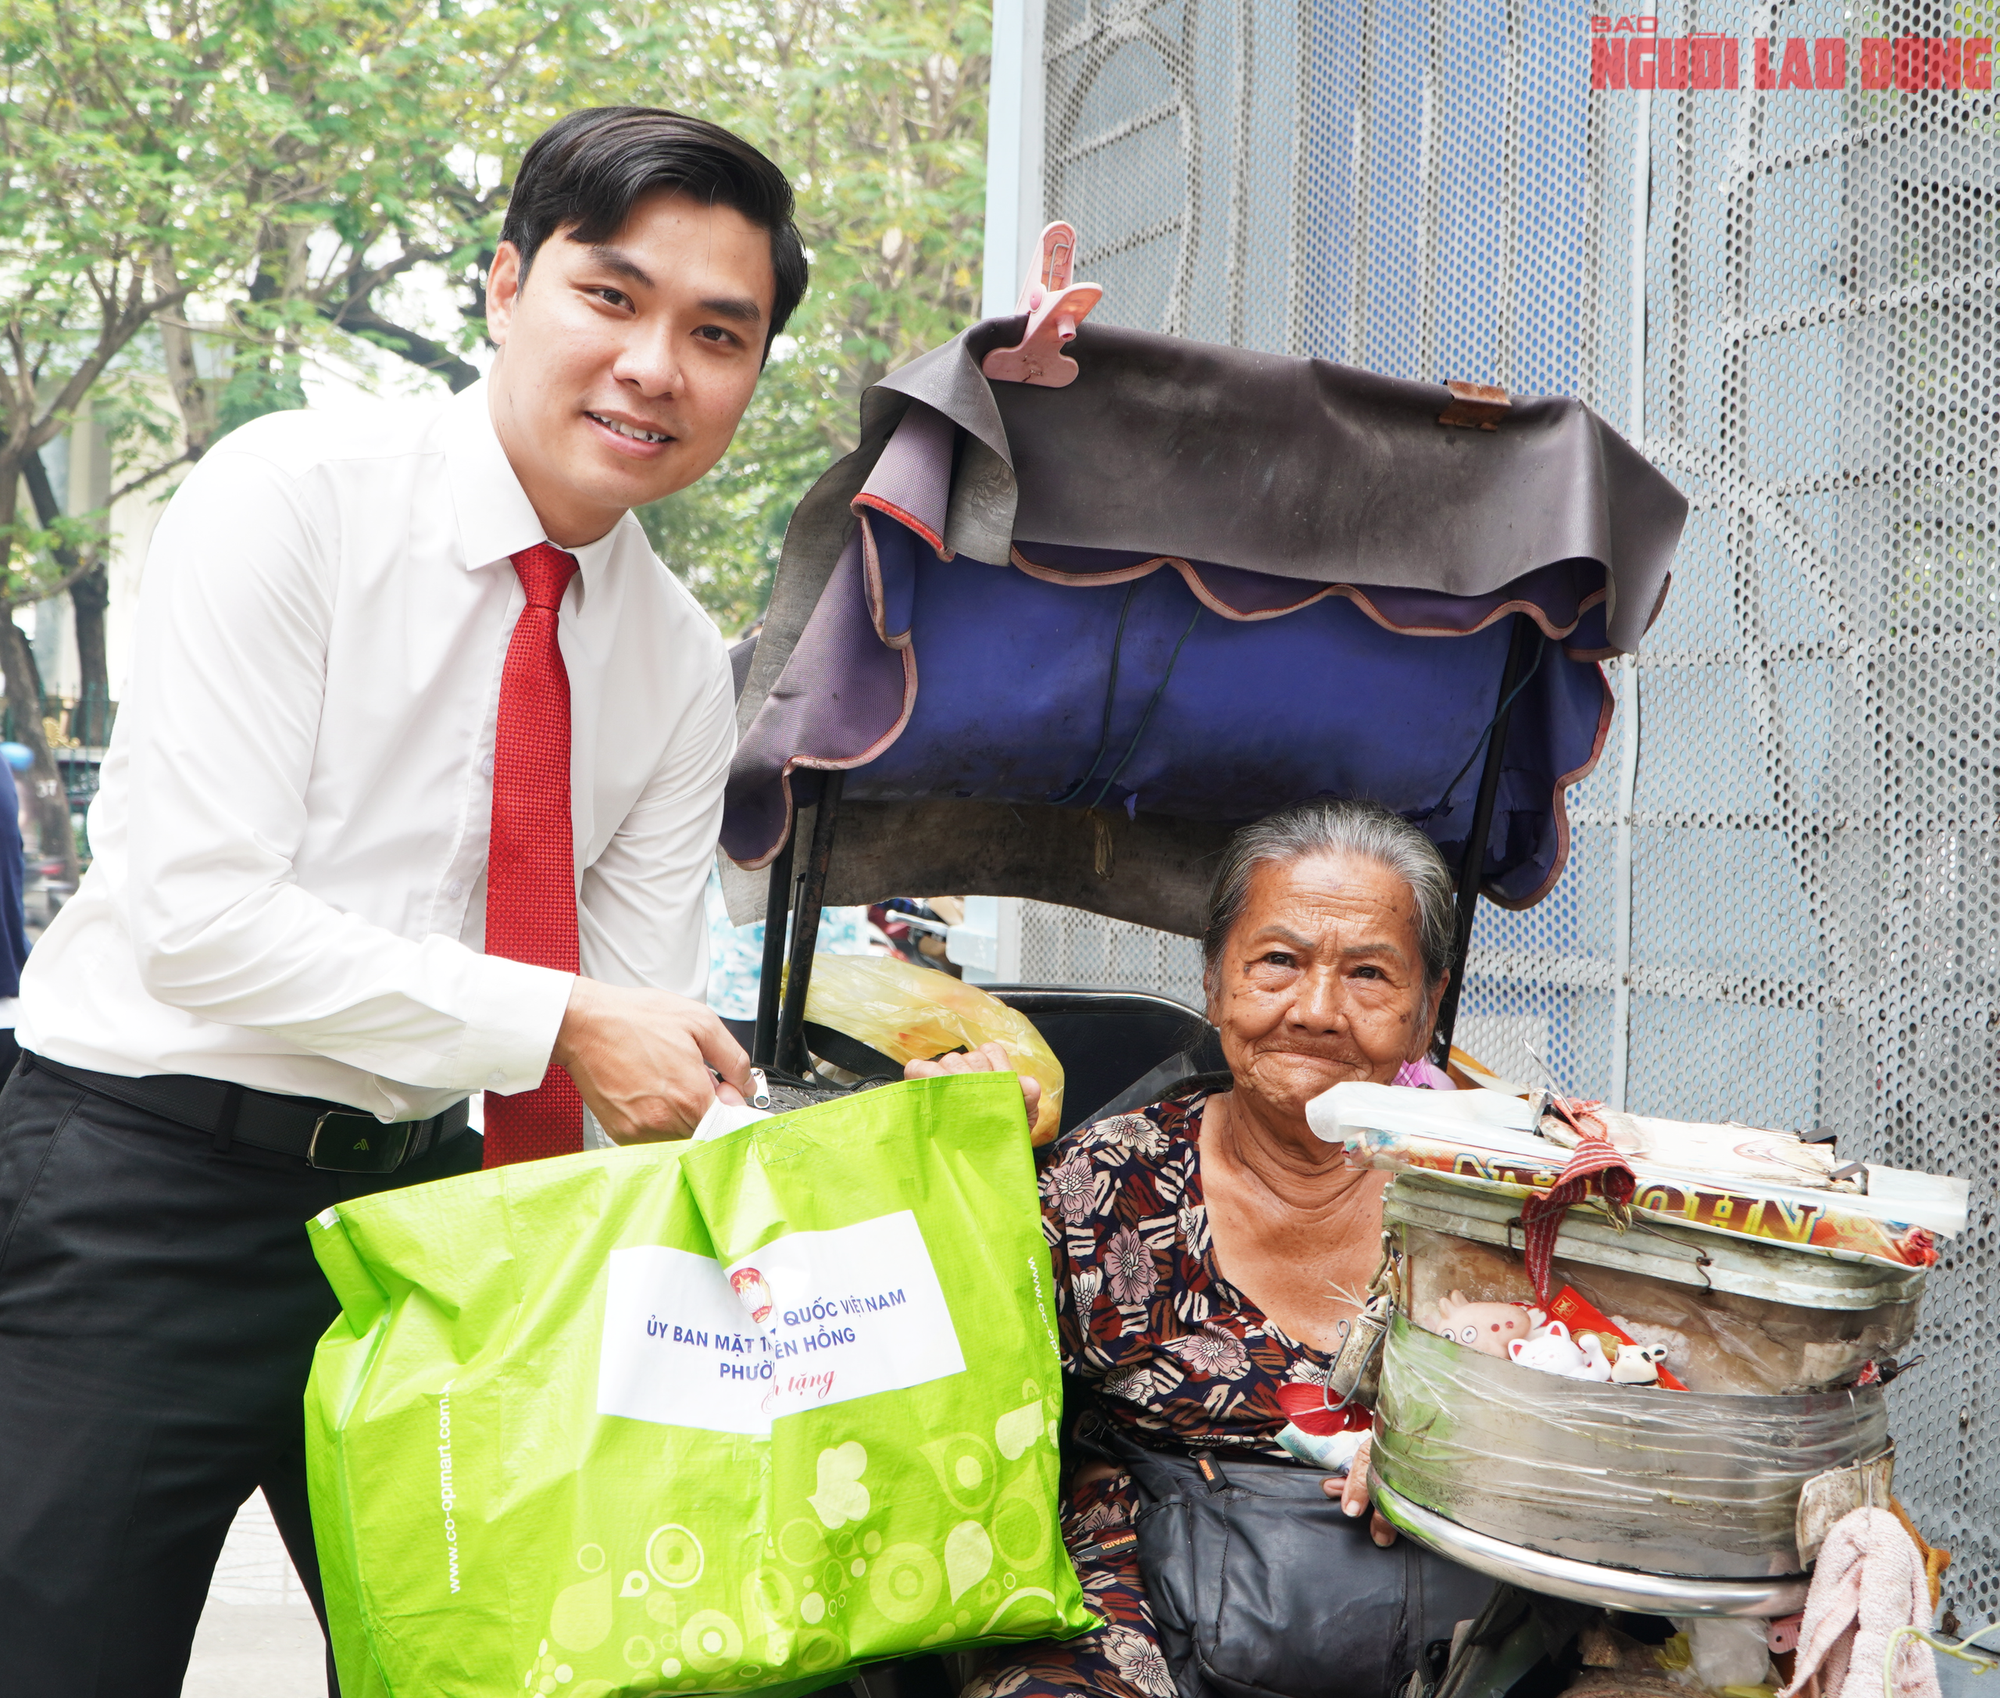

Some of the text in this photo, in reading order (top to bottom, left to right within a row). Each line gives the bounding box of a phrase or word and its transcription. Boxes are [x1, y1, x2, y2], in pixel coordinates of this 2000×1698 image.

[646, 1315, 669, 1339] ỦY
[673, 1327, 708, 1348] BAN
[715, 1333, 755, 1357] MẶT
[783, 1297, 839, 1327] QUỐC
[840, 1295, 865, 1318] VIỆT
[865, 1288, 907, 1312] NAM
[719, 1359, 776, 1381] PHƯỜ
[804, 1323, 857, 1353] HỒNG
[788, 1369, 838, 1400] tặng
